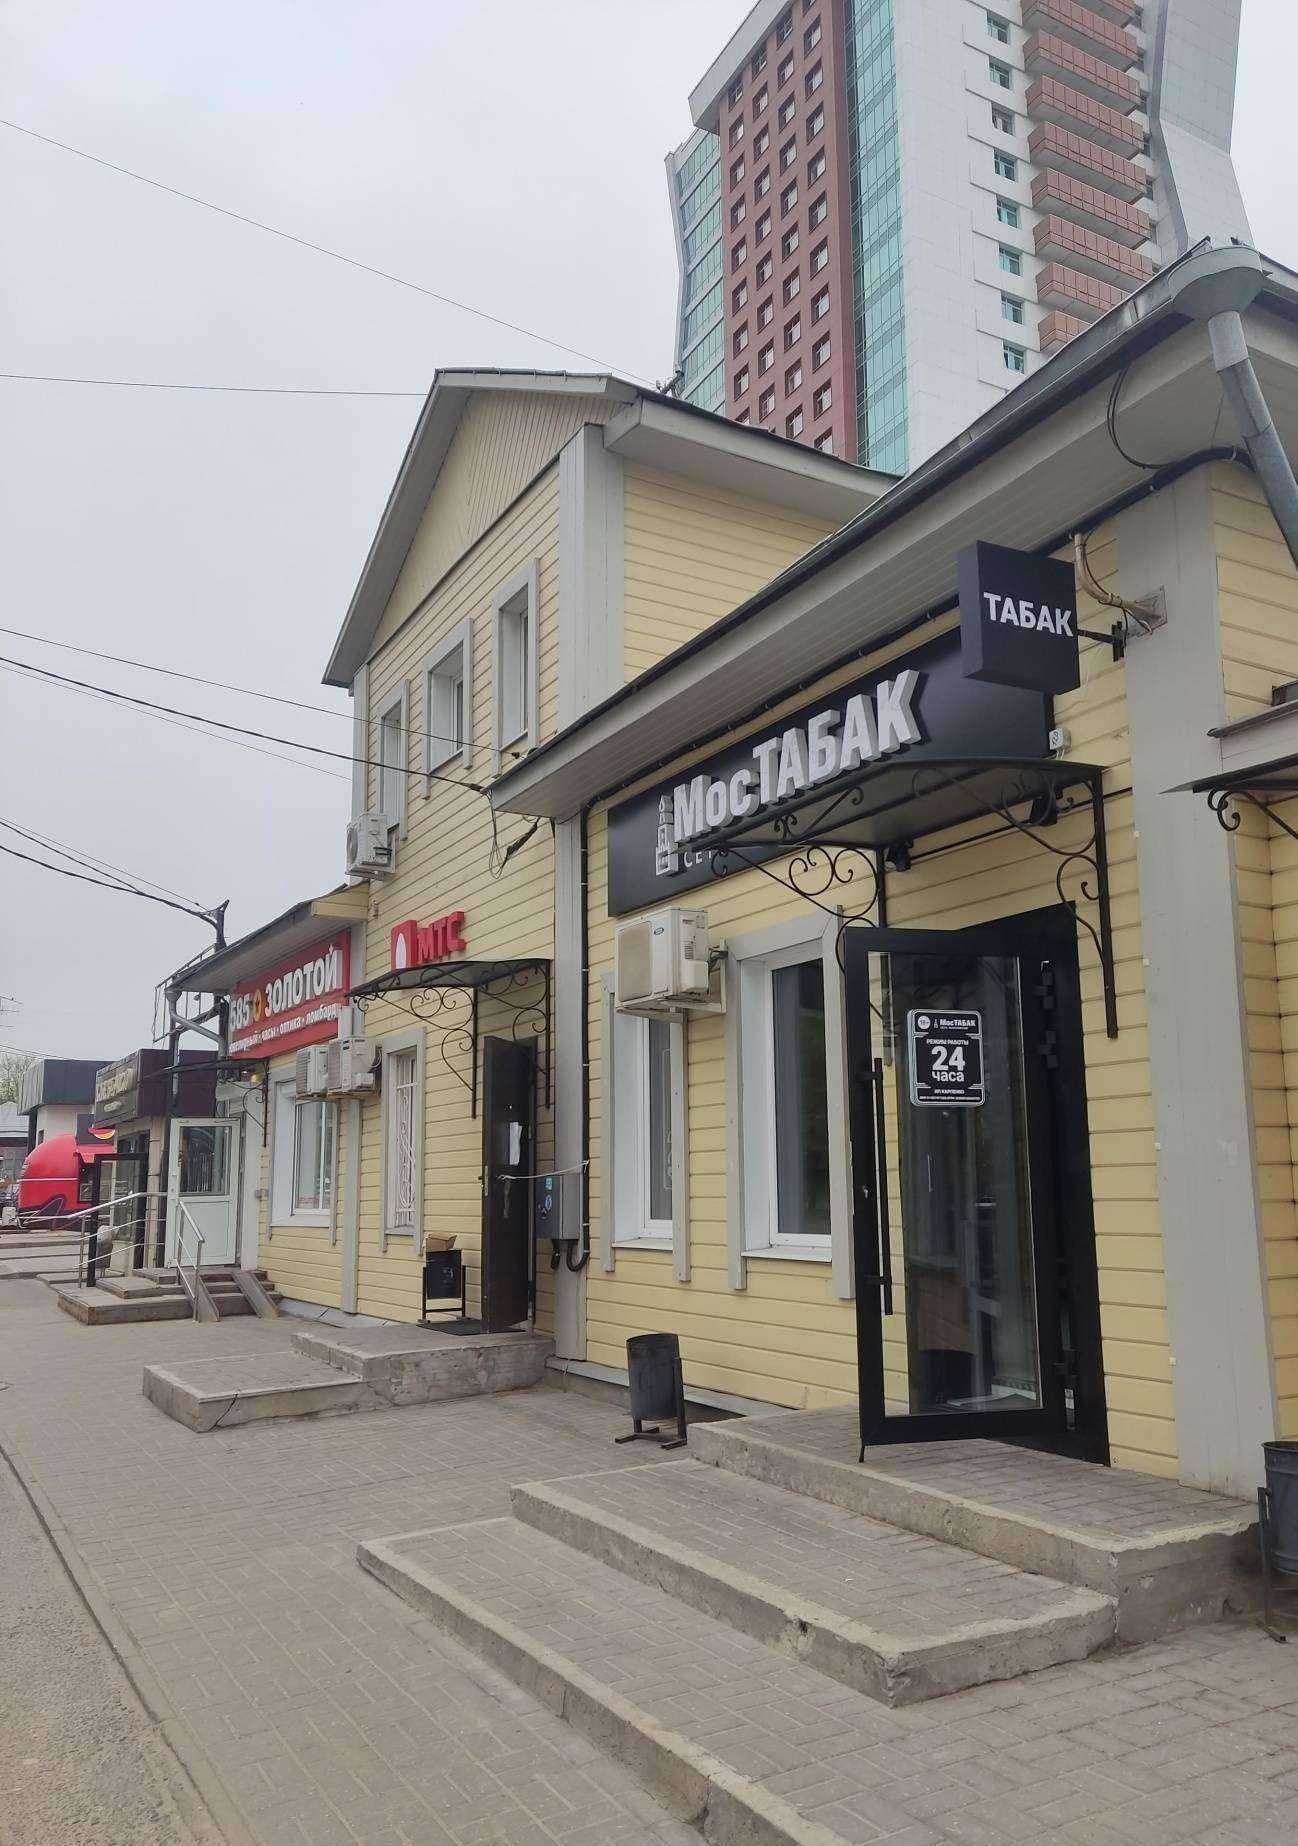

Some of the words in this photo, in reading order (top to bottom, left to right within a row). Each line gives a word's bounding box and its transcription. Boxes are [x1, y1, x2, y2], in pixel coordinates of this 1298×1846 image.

[983, 591, 1073, 637] ТАБАК
[674, 669, 921, 842] МосТАБАК
[417, 911, 466, 964] МТС
[230, 993, 252, 1031] 585
[265, 944, 343, 1017] ЗОЛОТОЙ
[279, 1015, 301, 1035] оптика
[305, 1003, 337, 1025] ломбард
[931, 1045, 966, 1071] 24
[931, 1071, 965, 1082] часа
